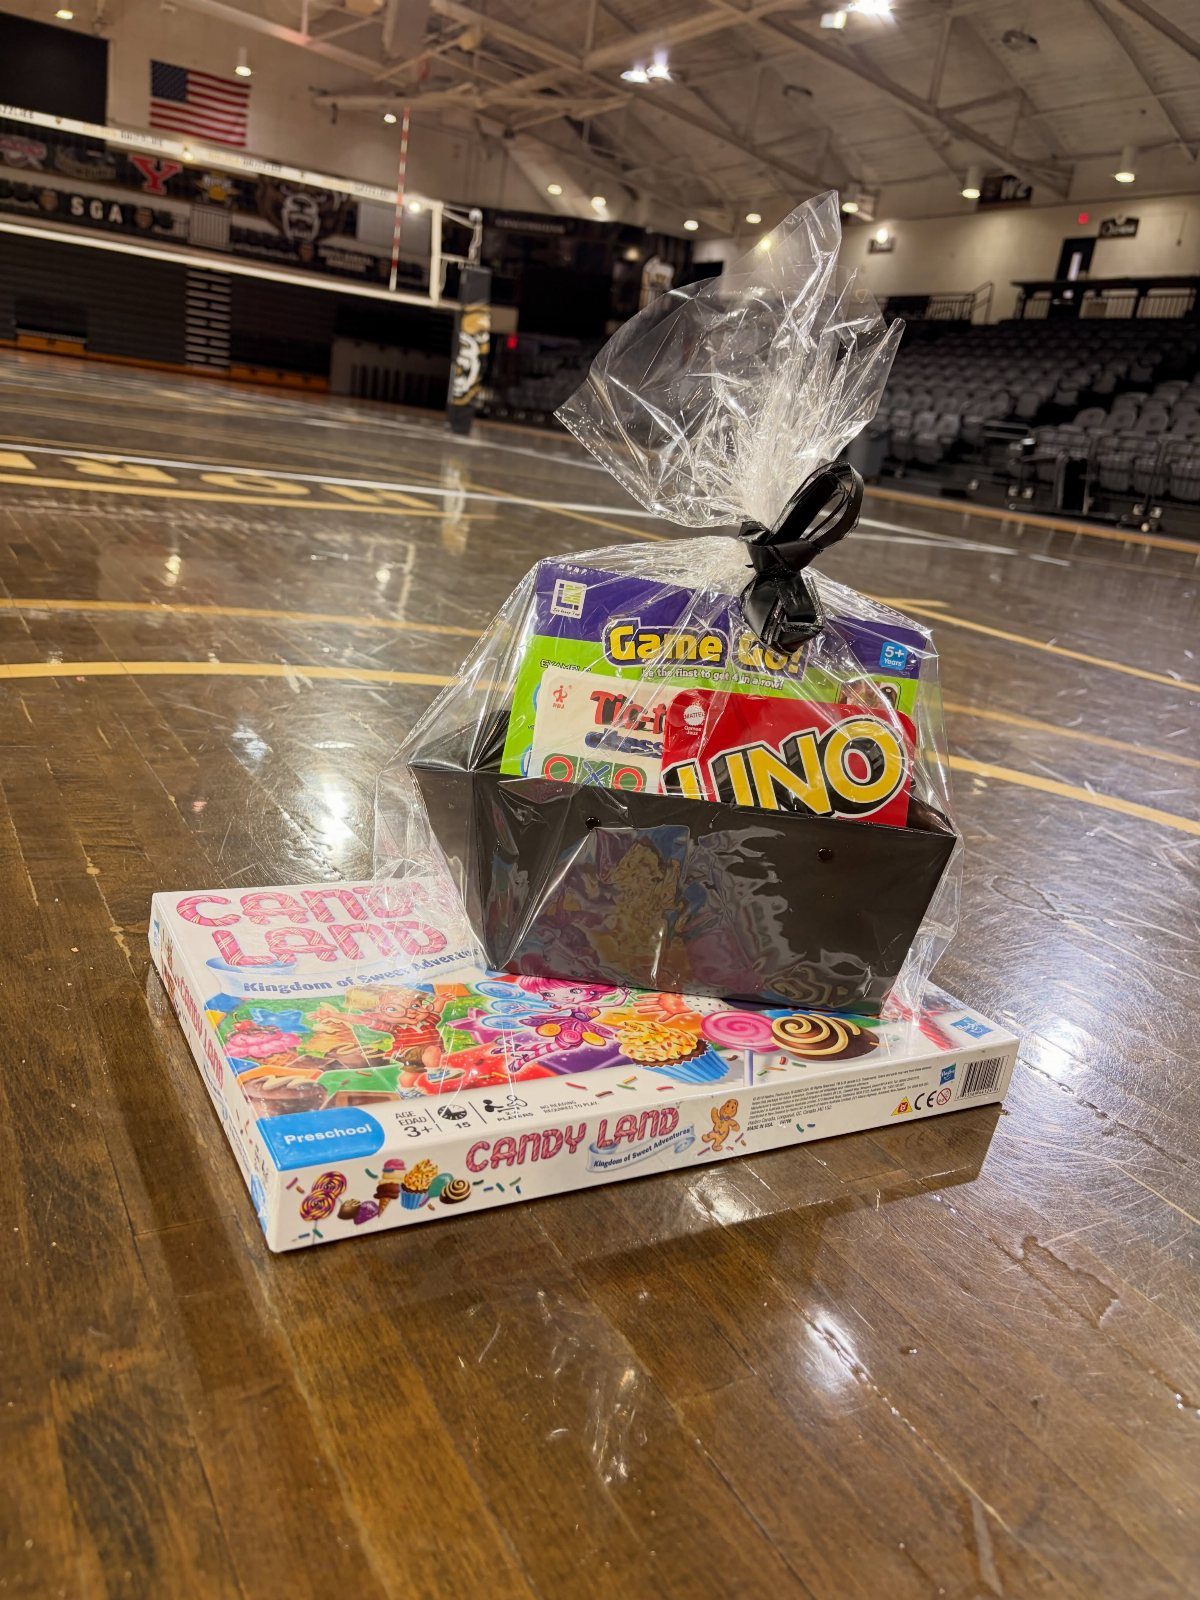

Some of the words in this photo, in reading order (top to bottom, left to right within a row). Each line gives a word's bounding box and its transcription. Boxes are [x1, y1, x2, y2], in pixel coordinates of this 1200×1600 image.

[128, 153, 183, 195] Y
[608, 625, 723, 662] Game
[884, 646, 905, 658] 5+
[884, 658, 902, 667] Years
[700, 669, 711, 678] to
[713, 670, 729, 681] get
[731, 671, 738, 681] 4
[740, 674, 750, 683] in
[752, 677, 759, 685] a
[211, 920, 448, 966] LAND
[243, 980, 333, 995] Kingdom
[337, 975, 355, 988] of
[395, 1110, 417, 1120] AGE
[399, 1116, 427, 1127] EDAD
[284, 1123, 373, 1145] Preschool
[404, 1125, 433, 1138] 3+
[466, 1122, 586, 1173] CANDY
[597, 1107, 680, 1149] LAND
[593, 1158, 622, 1168] Kingdom
[632, 1145, 652, 1159] Sweet
[653, 1127, 691, 1149] Adventures
